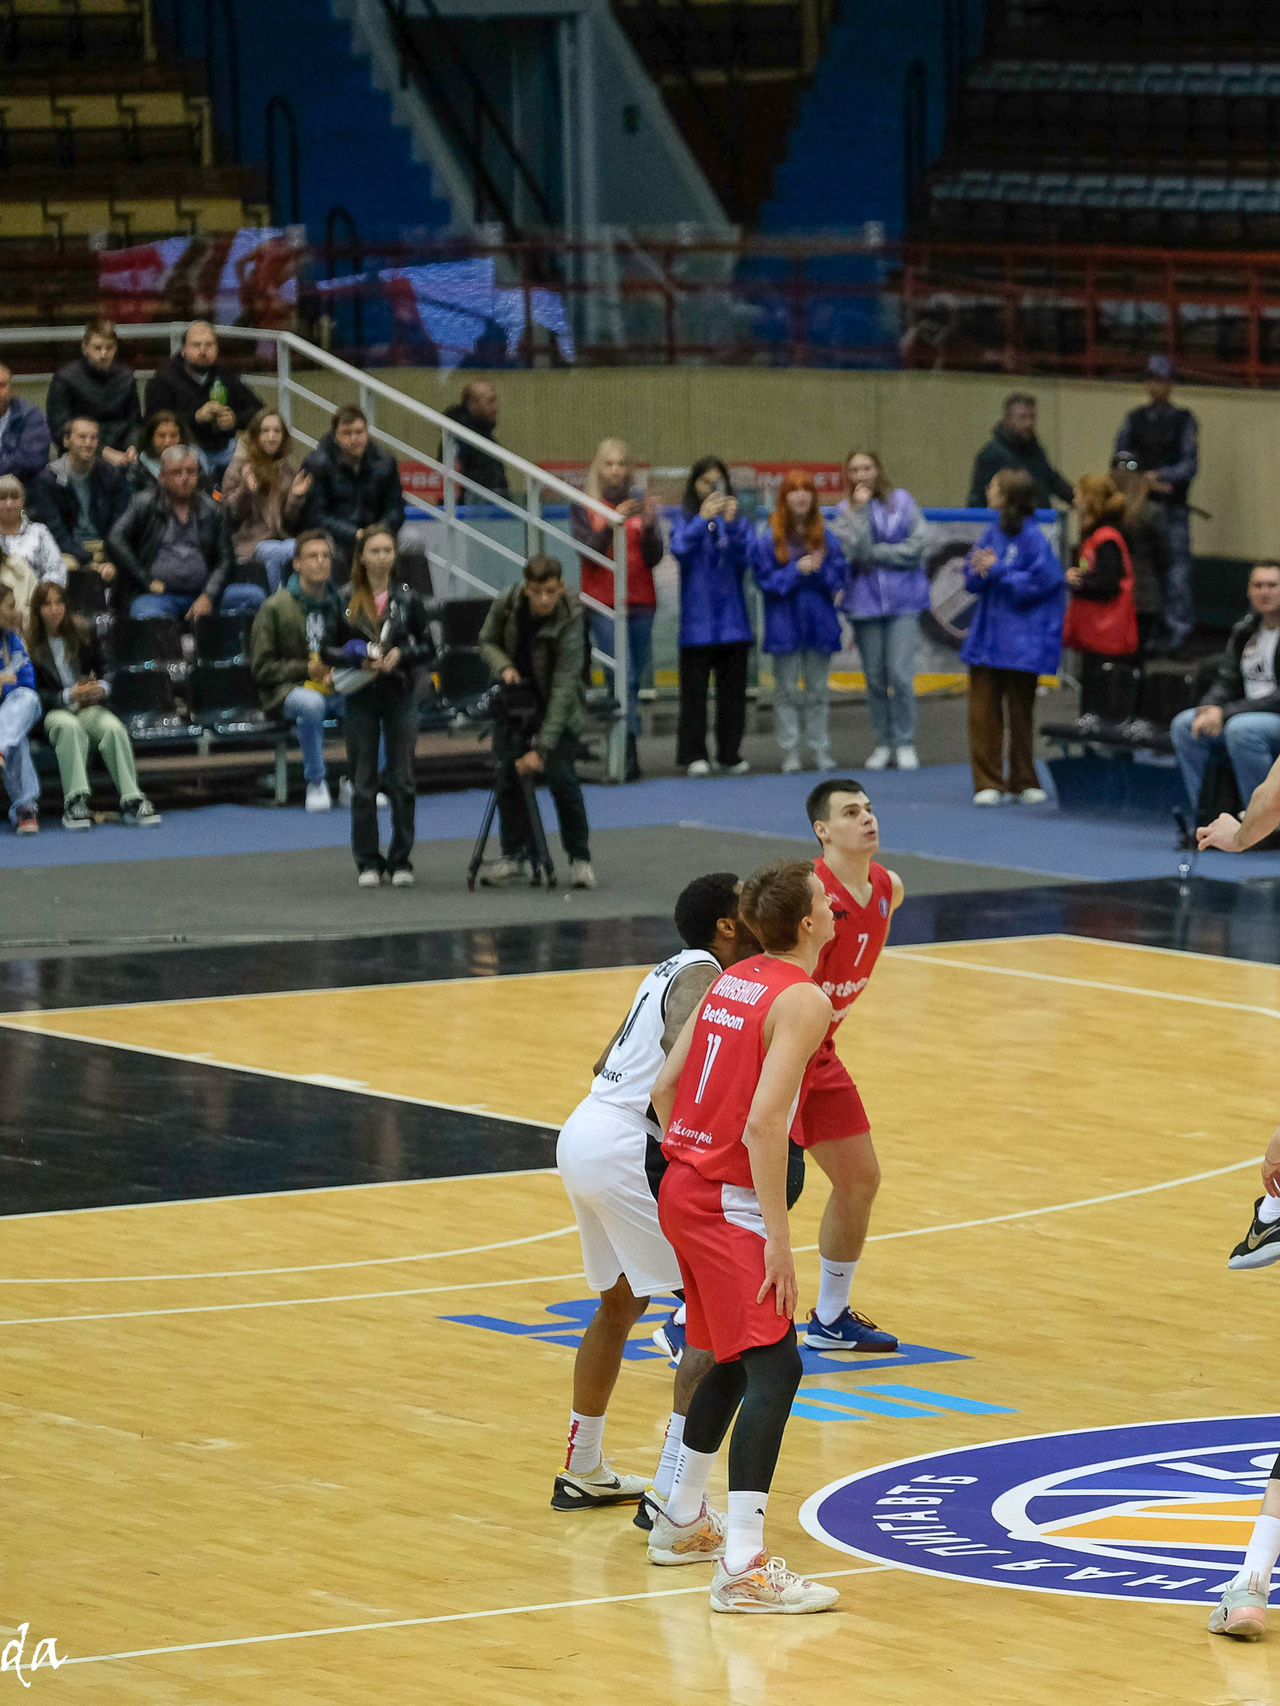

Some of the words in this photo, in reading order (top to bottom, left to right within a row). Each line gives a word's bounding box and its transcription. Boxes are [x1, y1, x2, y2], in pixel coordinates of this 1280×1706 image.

[857, 932, 869, 968] 7
[701, 1003, 745, 1031] BetBoom
[694, 1032, 722, 1104] 11
[875, 1474, 979, 1506] ВТБ
[872, 1509, 1013, 1557] ЛИГА
